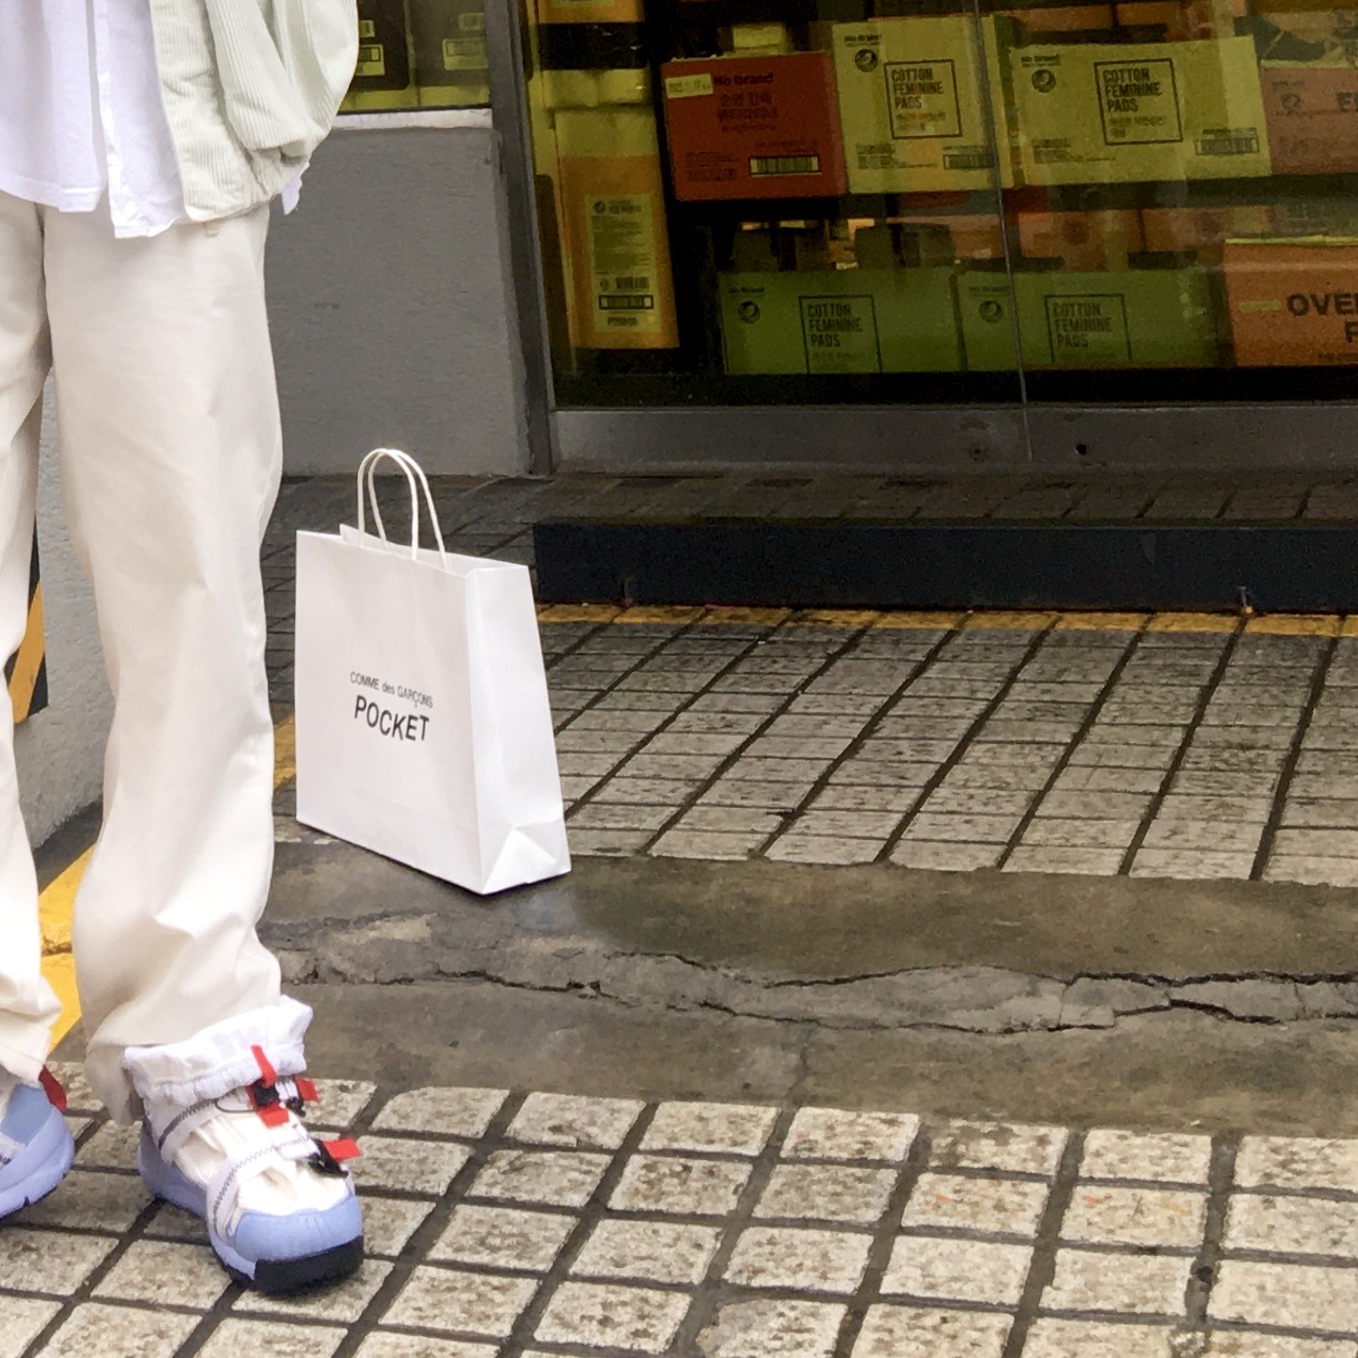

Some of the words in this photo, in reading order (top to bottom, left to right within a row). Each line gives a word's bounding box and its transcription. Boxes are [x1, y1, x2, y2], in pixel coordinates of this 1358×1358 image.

[1102, 68, 1152, 83] COTTON
[1104, 82, 1163, 99] FEMININE
[1106, 98, 1139, 113] PADS
[808, 303, 852, 318] COTTON
[809, 317, 864, 333] FEMININE
[810, 333, 842, 348] PADS
[349, 670, 381, 691] COMME
[381, 681, 396, 696] des
[396, 684, 434, 710] GARÇONS
[353, 694, 431, 742] POCKET
